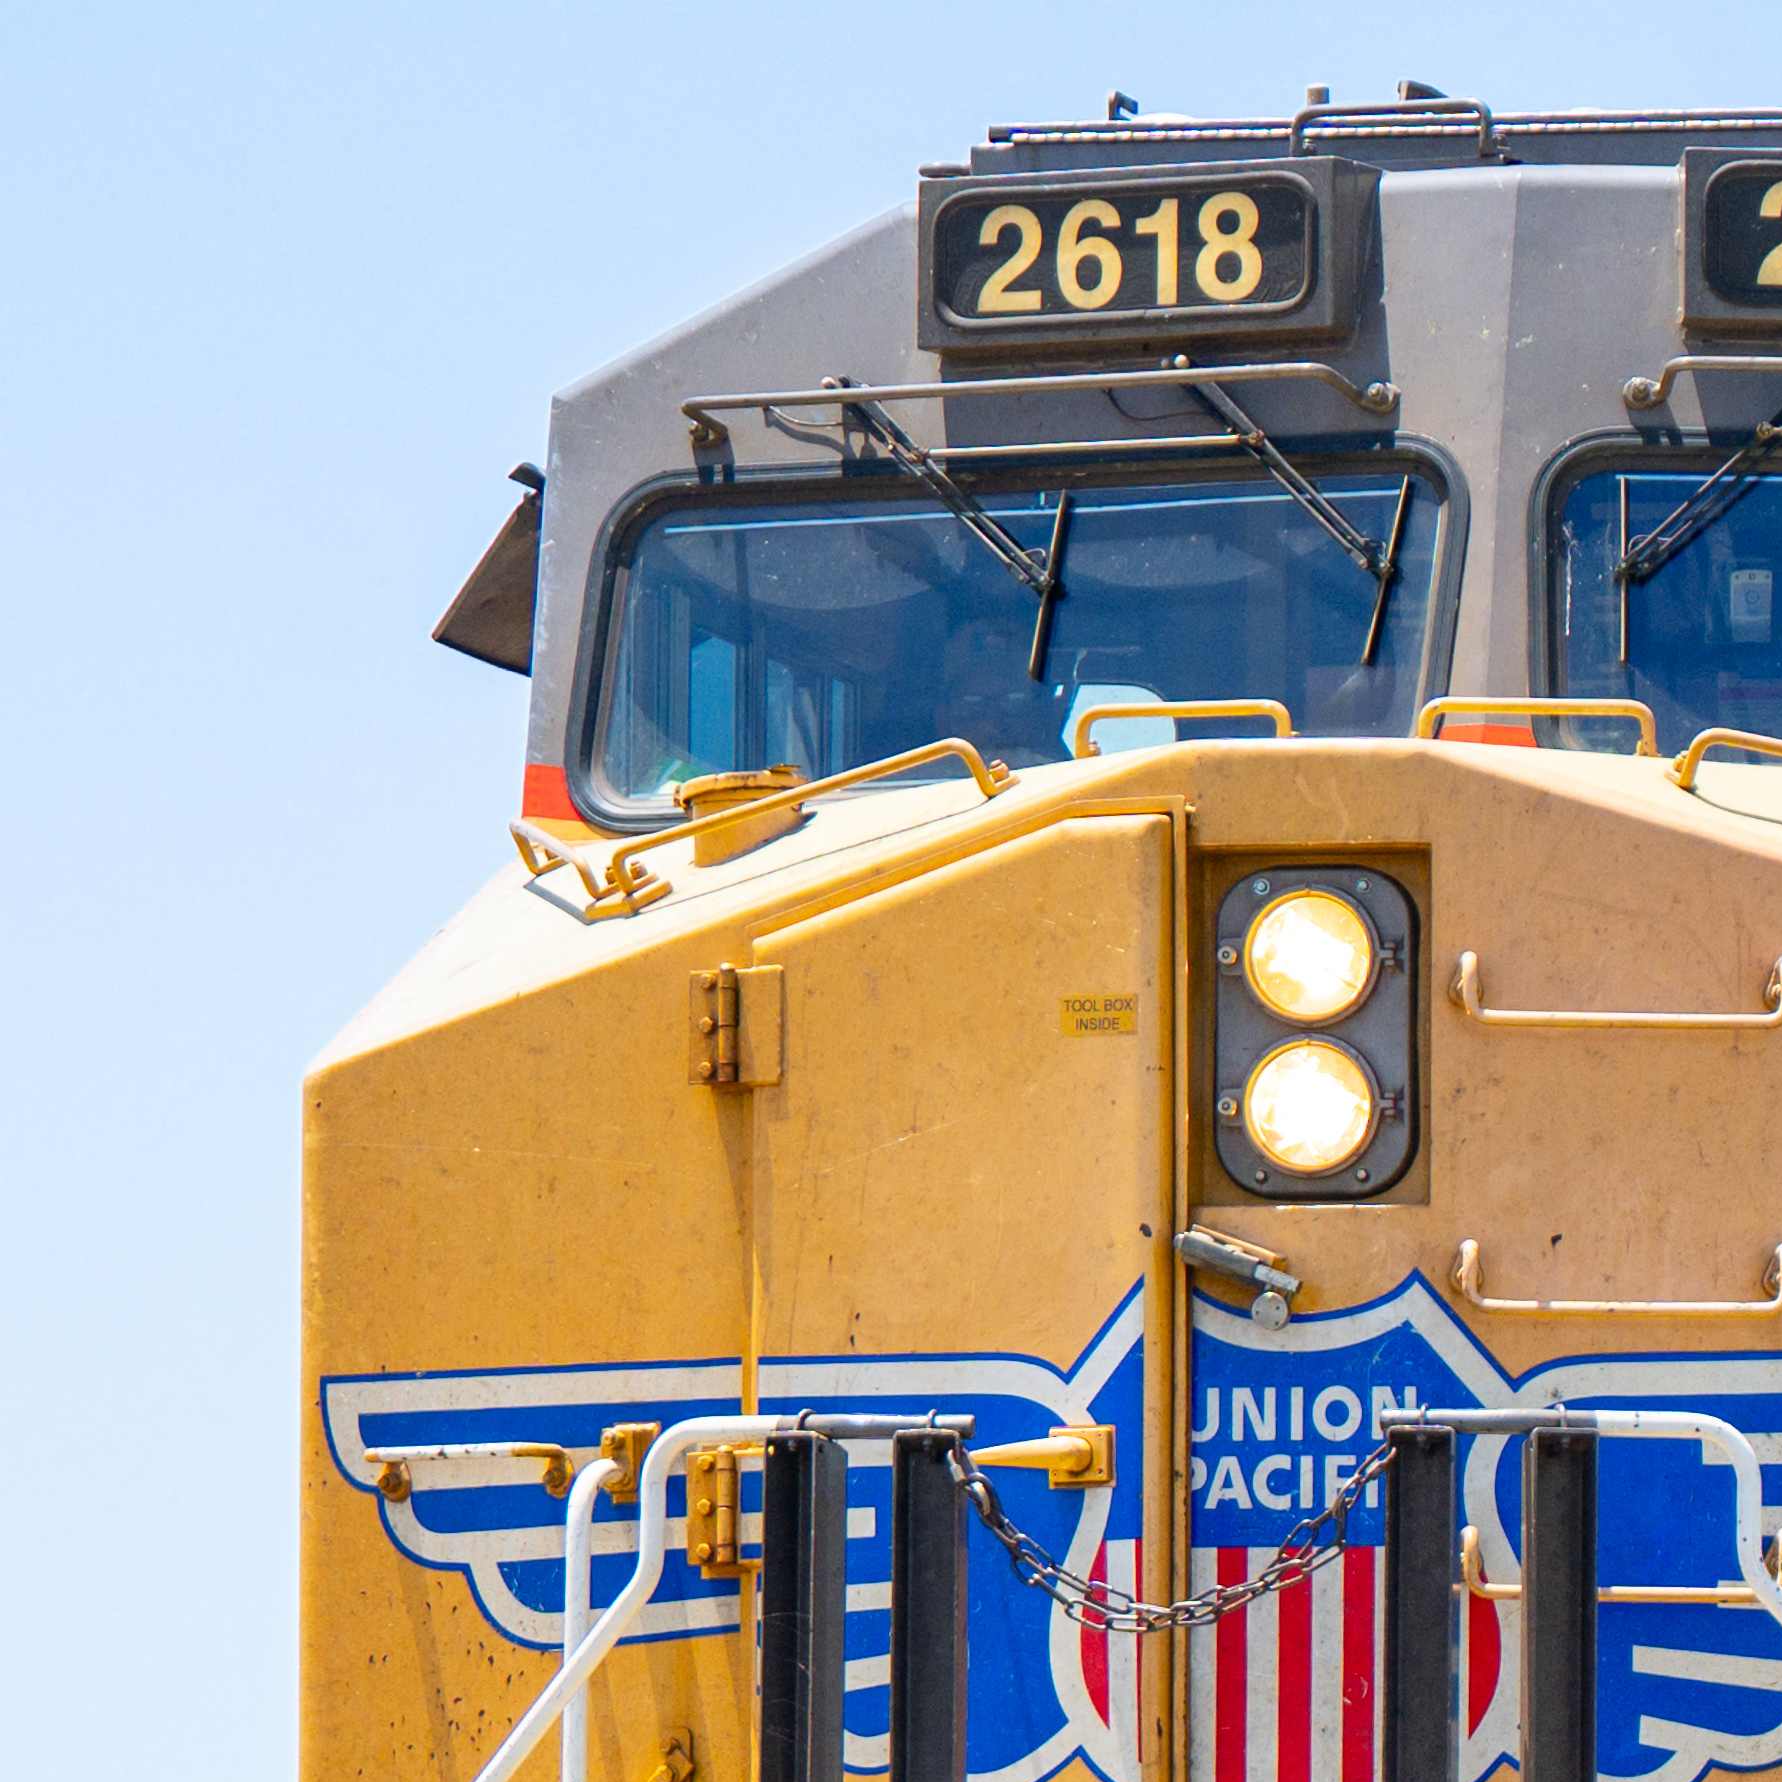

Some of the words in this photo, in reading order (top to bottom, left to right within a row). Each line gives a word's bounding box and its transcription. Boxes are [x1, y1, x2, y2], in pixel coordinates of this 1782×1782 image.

[976, 191, 1264, 314] 2618
[1063, 999, 1099, 1013] TOOL
[1104, 998, 1133, 1011] BOX
[1075, 1017, 1120, 1031] INSIDE
[1191, 1454, 1379, 1511] ACIFI
